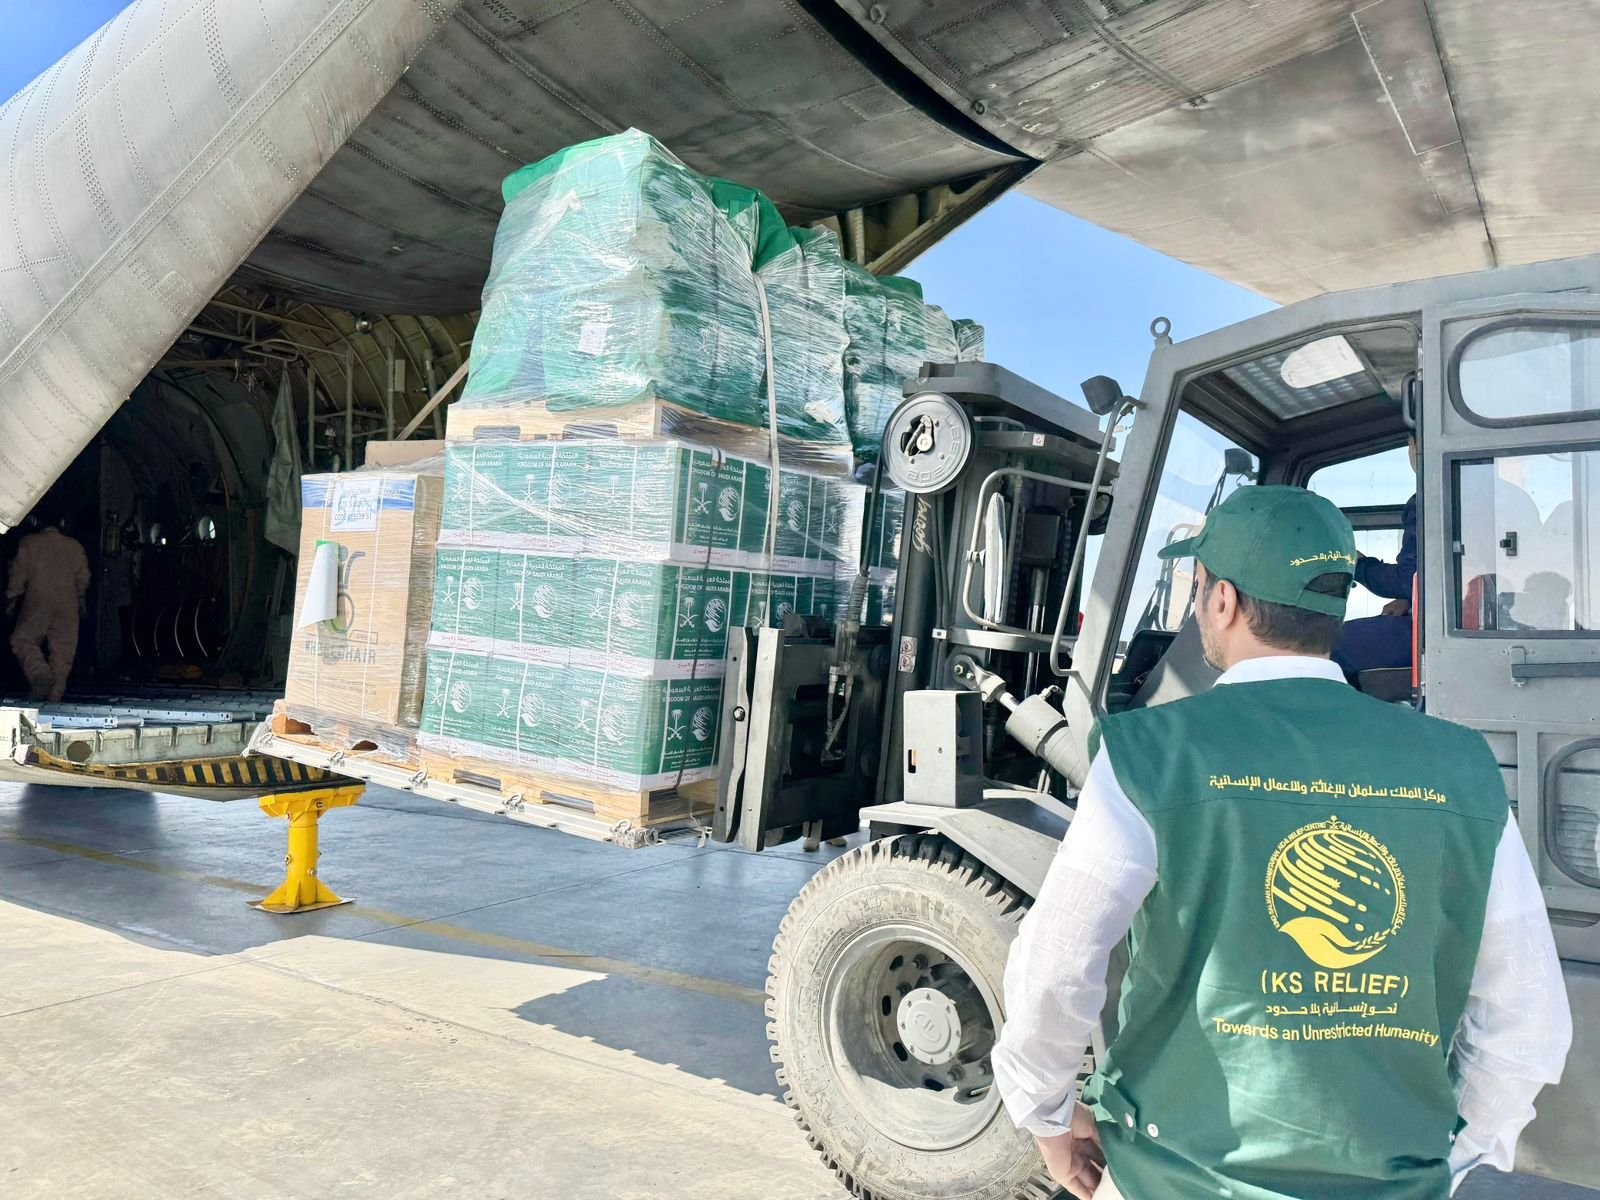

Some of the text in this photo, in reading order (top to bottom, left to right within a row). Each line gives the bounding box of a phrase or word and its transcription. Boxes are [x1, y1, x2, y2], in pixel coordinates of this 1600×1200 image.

[1209, 774, 1261, 791] الإنسانية
[1348, 783, 1388, 798] سلمان
[1390, 786, 1420, 799] الملك
[1420, 788, 1446, 804] مركز
[1261, 970, 1409, 998] (KS RELIEF)
[1265, 1001, 1398, 1018] نحو إنسانية بلا حدود
[1212, 1016, 1440, 1047] Towards an Unrestricted Humanity
